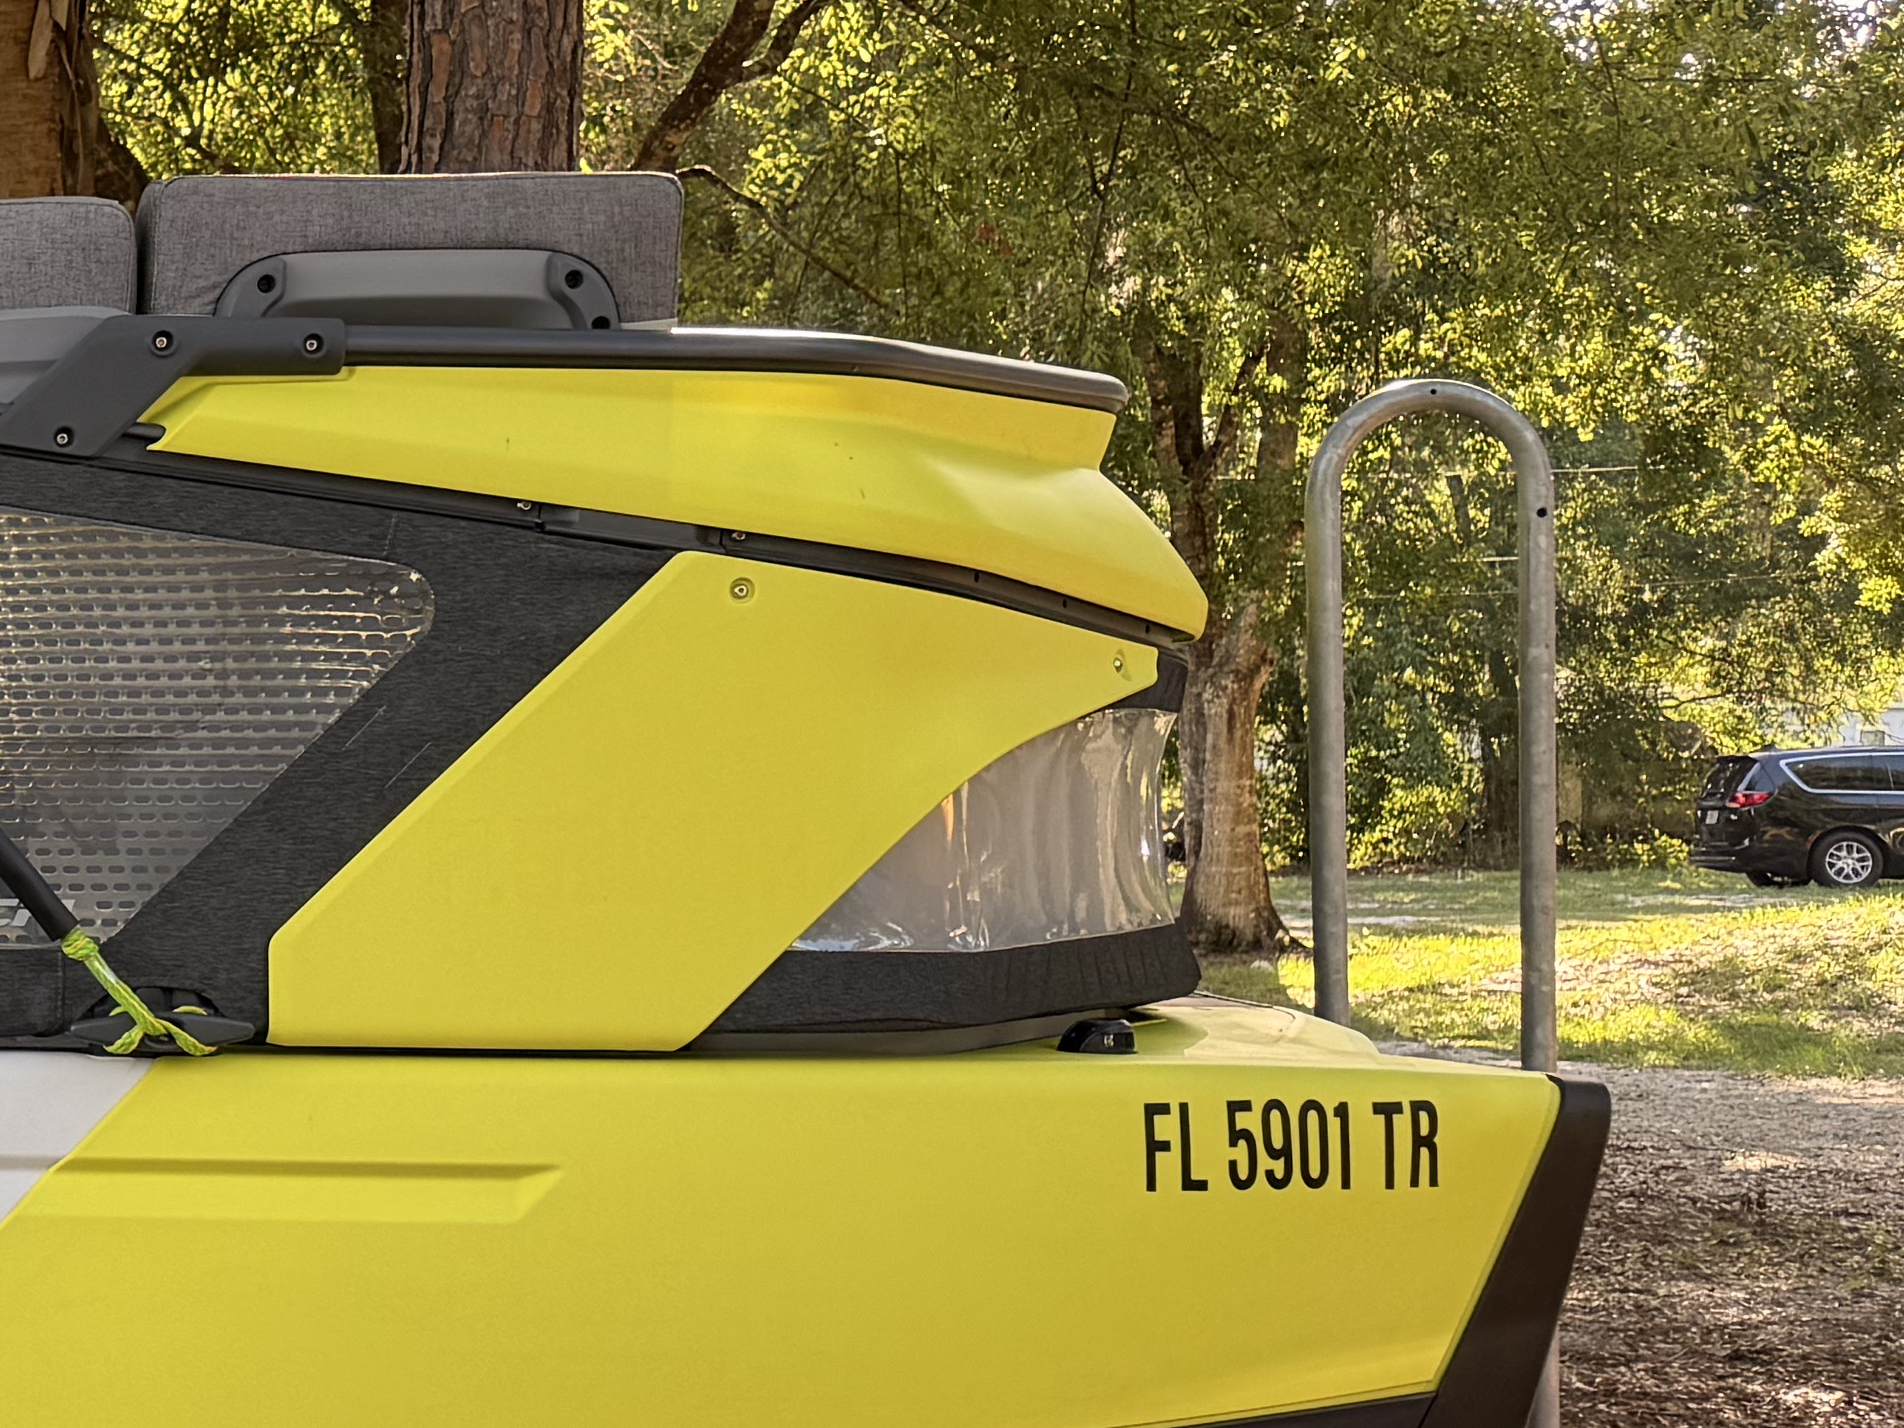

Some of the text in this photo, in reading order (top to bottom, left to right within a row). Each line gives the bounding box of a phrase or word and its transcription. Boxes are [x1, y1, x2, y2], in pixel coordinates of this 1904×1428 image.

[1143, 1098, 1440, 1192] FL 5901 TR
